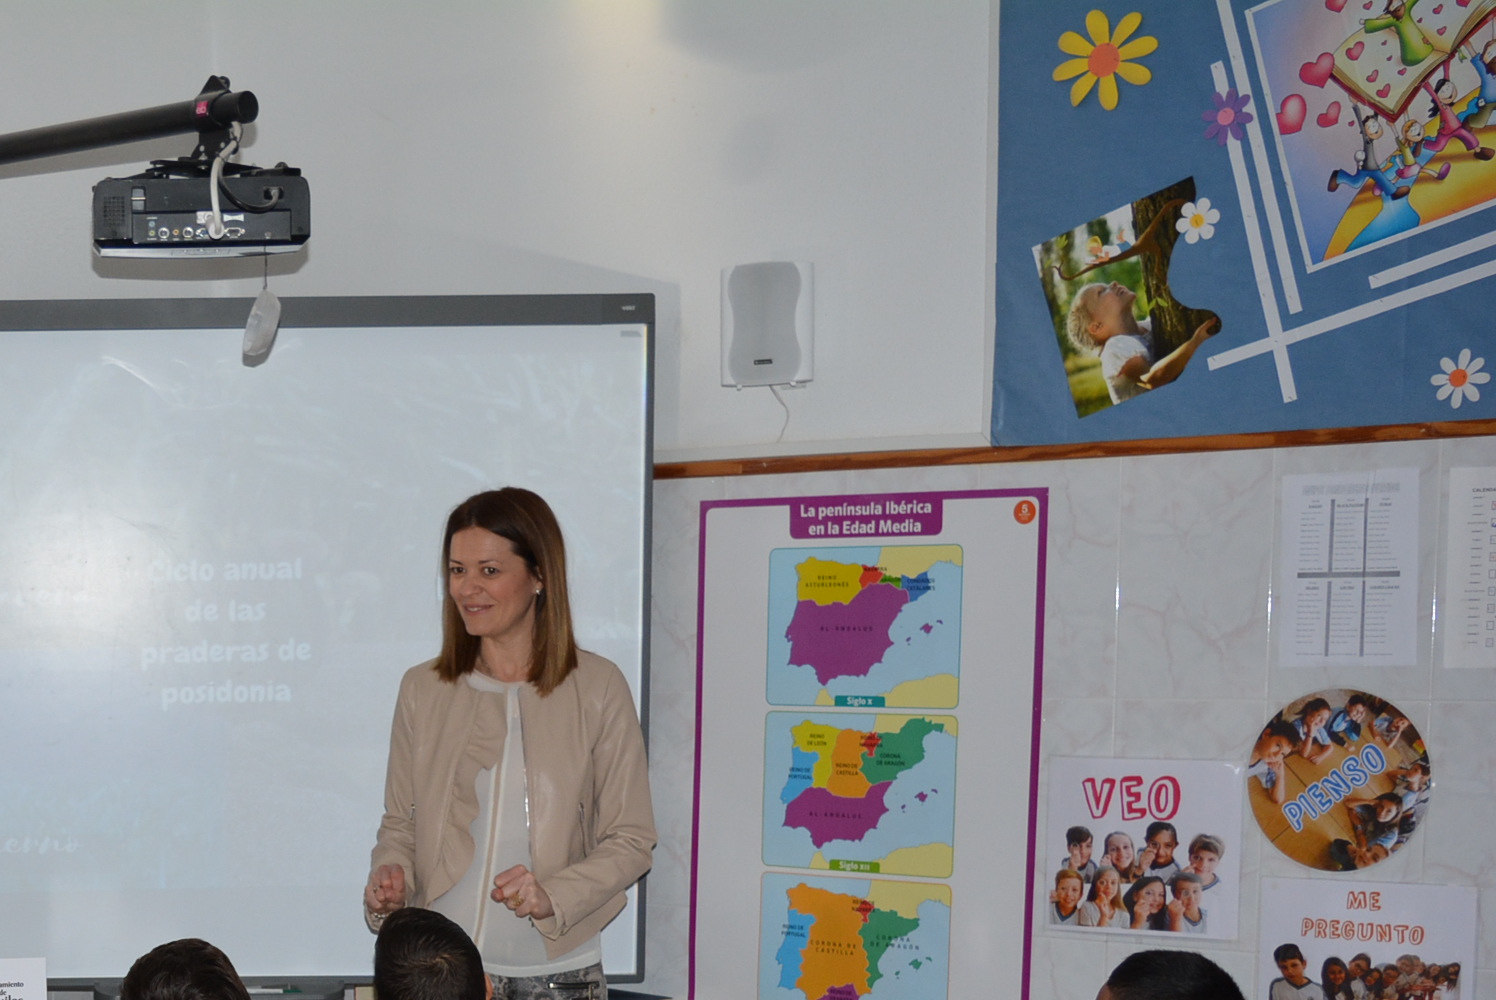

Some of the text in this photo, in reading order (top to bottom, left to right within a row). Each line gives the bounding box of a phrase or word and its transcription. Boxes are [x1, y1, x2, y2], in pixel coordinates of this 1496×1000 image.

[800, 500, 932, 520] La península Ibérica
[1021, 503, 1029, 514] 5
[808, 519, 922, 535] en la Edad Media
[146, 557, 303, 584] Ciclo anual
[185, 599, 267, 623] de las
[141, 636, 312, 671] praderas de
[160, 678, 293, 712] posidonia
[846, 697, 866, 707] Siglo
[1082, 774, 1182, 821] VEO
[1280, 742, 1387, 833] PIENSO
[839, 861, 858, 872] Siglo
[1346, 891, 1382, 912] ME
[1300, 917, 1426, 946] PREGUNTO
